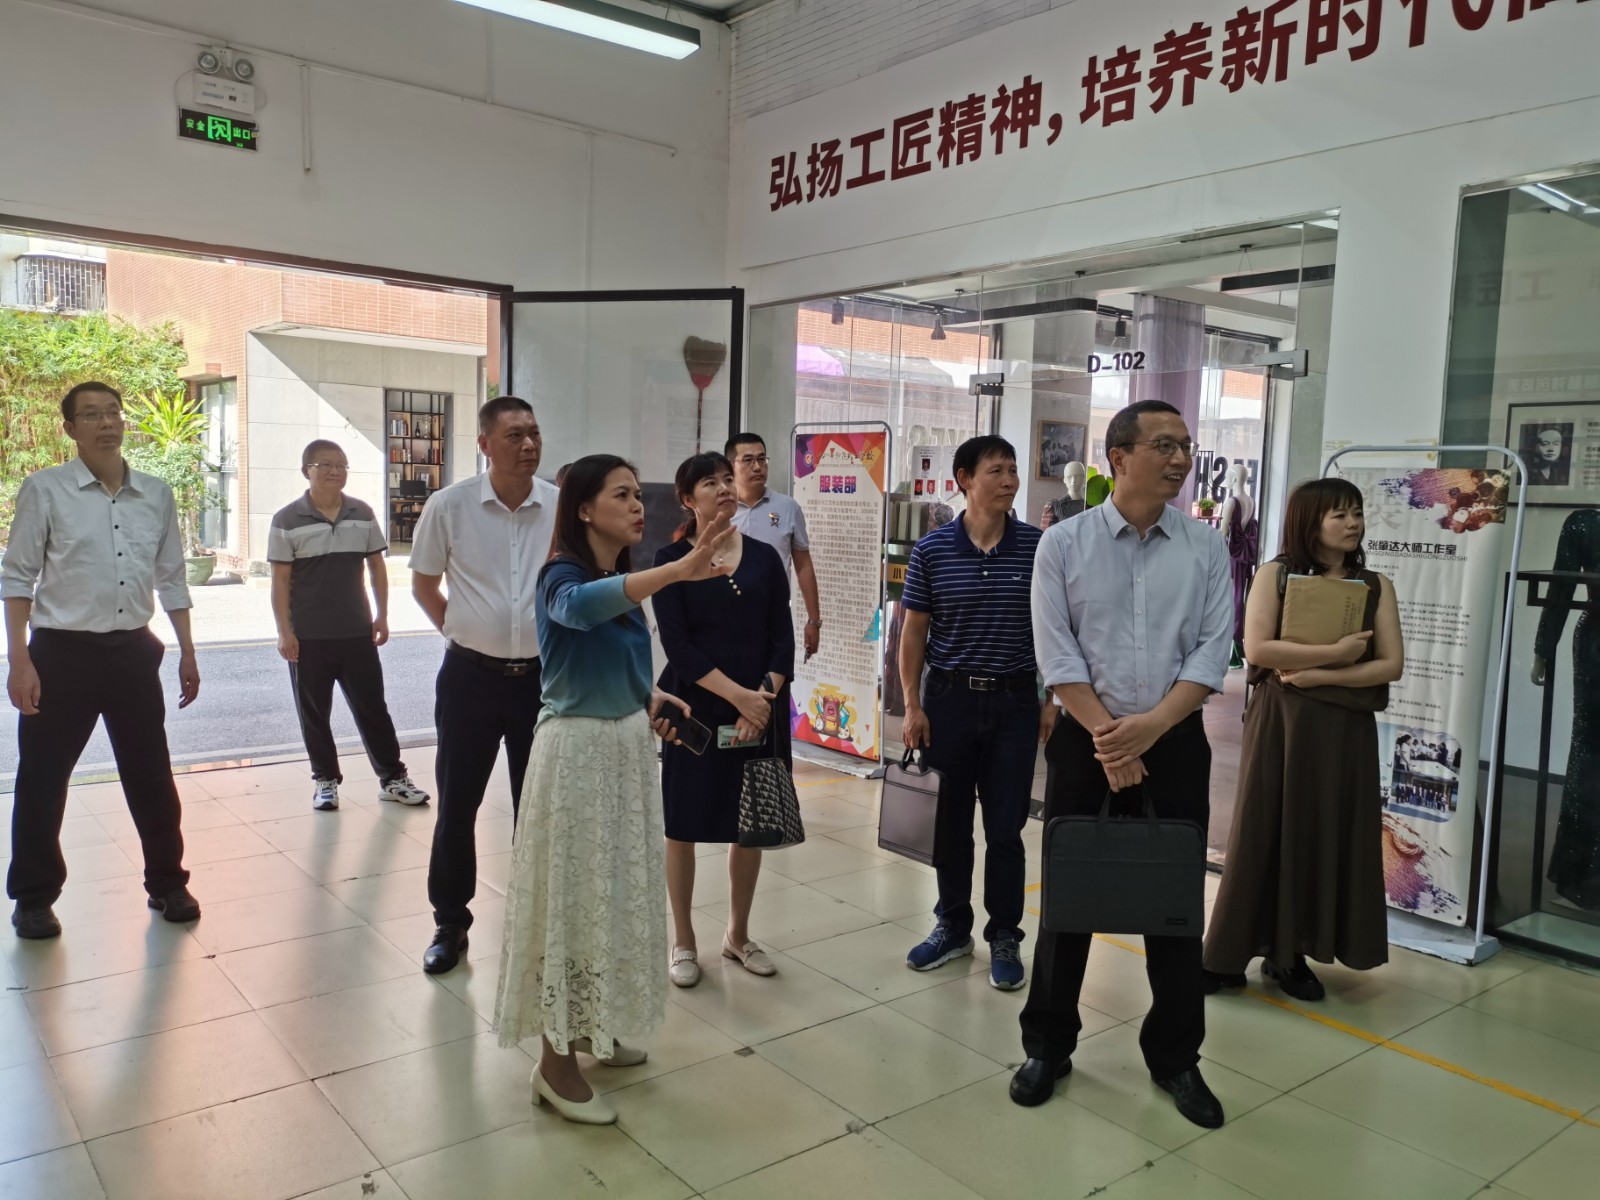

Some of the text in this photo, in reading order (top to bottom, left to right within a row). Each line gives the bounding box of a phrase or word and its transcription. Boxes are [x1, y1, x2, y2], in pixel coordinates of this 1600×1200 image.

[769, 0, 1600, 212] 弘扬工匠精神,培养新时代
[185, 119, 251, 140] 安全 出口
[1088, 351, 1146, 373] D-102
[819, 475, 857, 494] 服装部
[1367, 539, 1457, 555] 张肇达大师工作室
